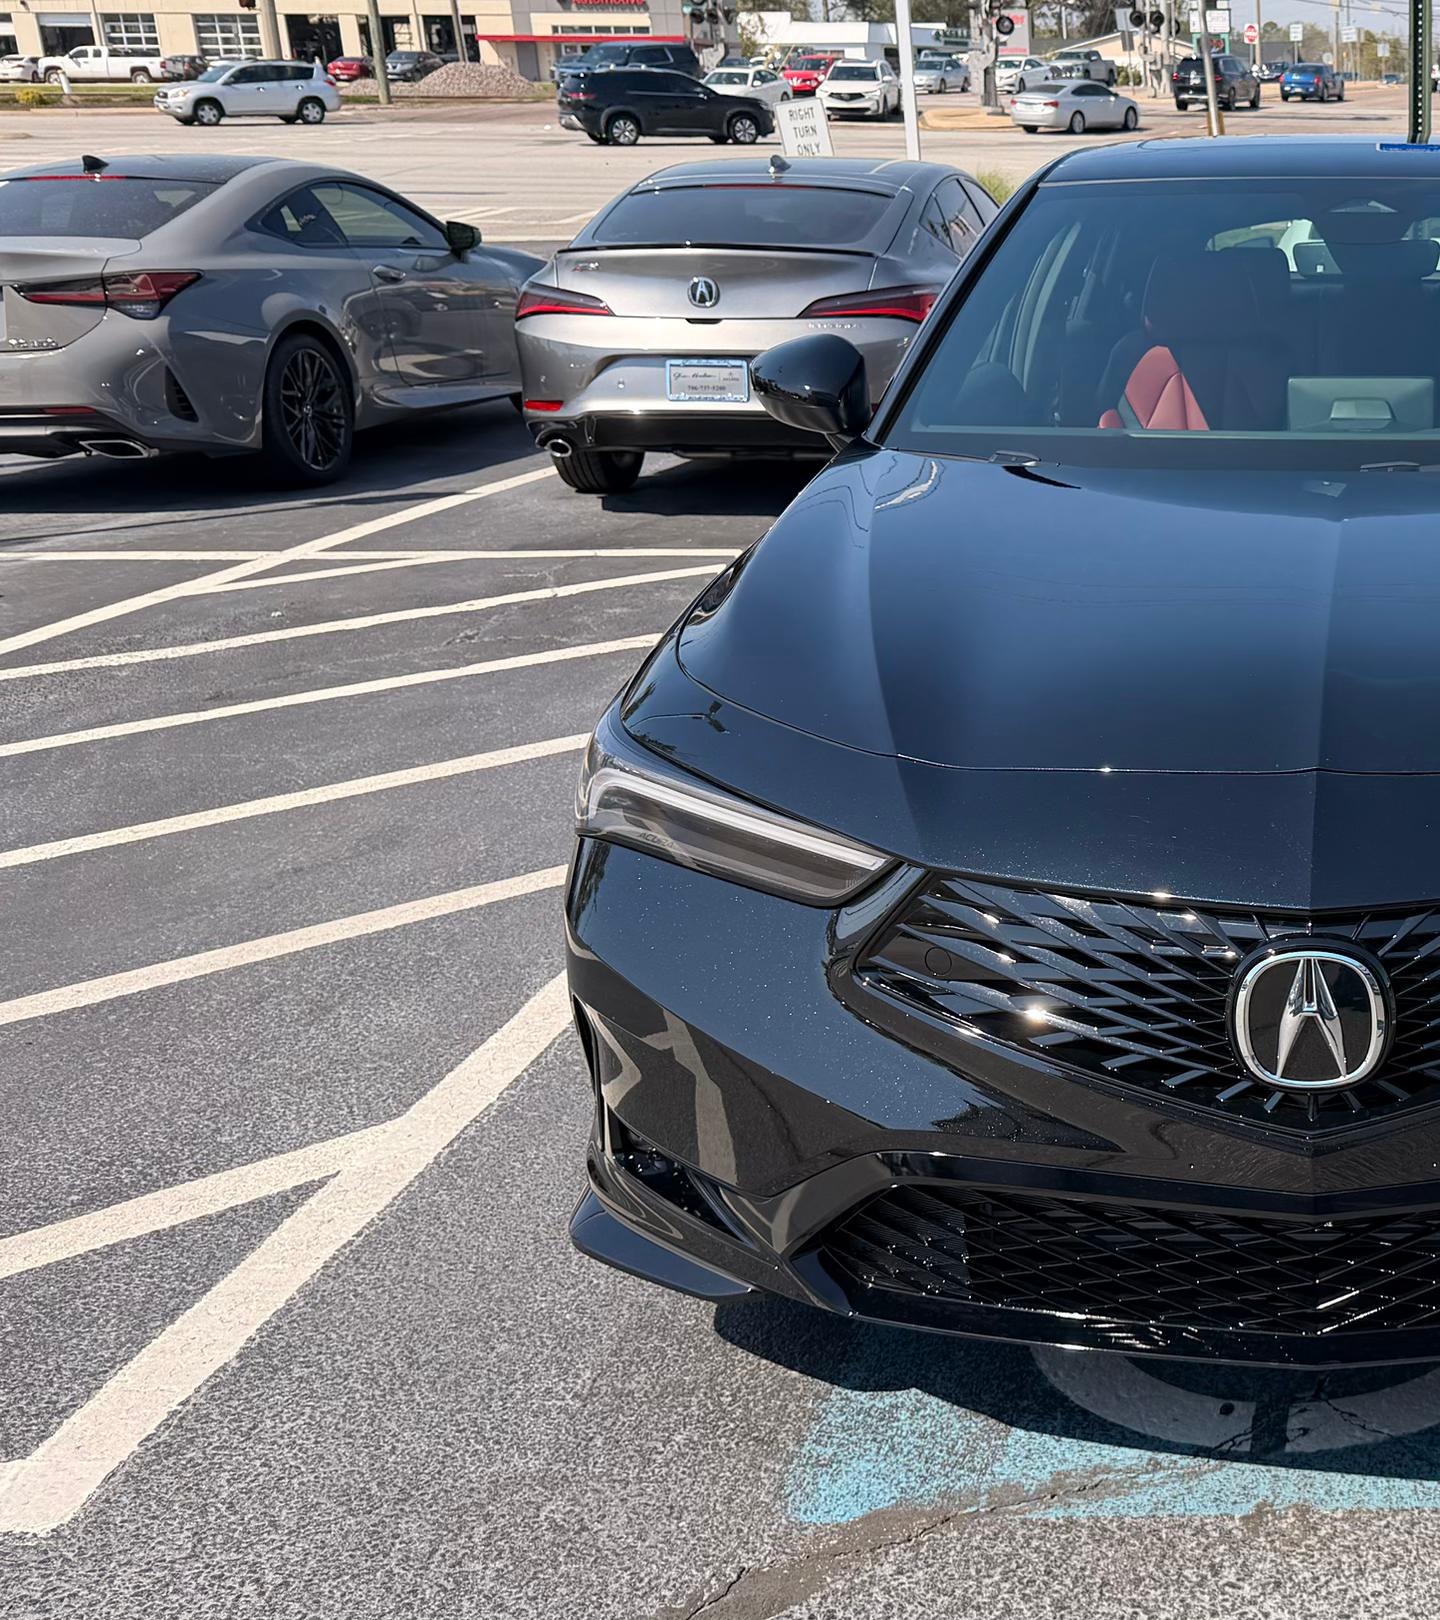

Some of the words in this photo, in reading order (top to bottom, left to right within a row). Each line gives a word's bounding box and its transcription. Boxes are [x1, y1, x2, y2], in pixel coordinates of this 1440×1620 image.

[788, 106, 815, 121] RIGHT
[793, 125, 817, 139] TURN
[797, 142, 820, 156] ONLY
